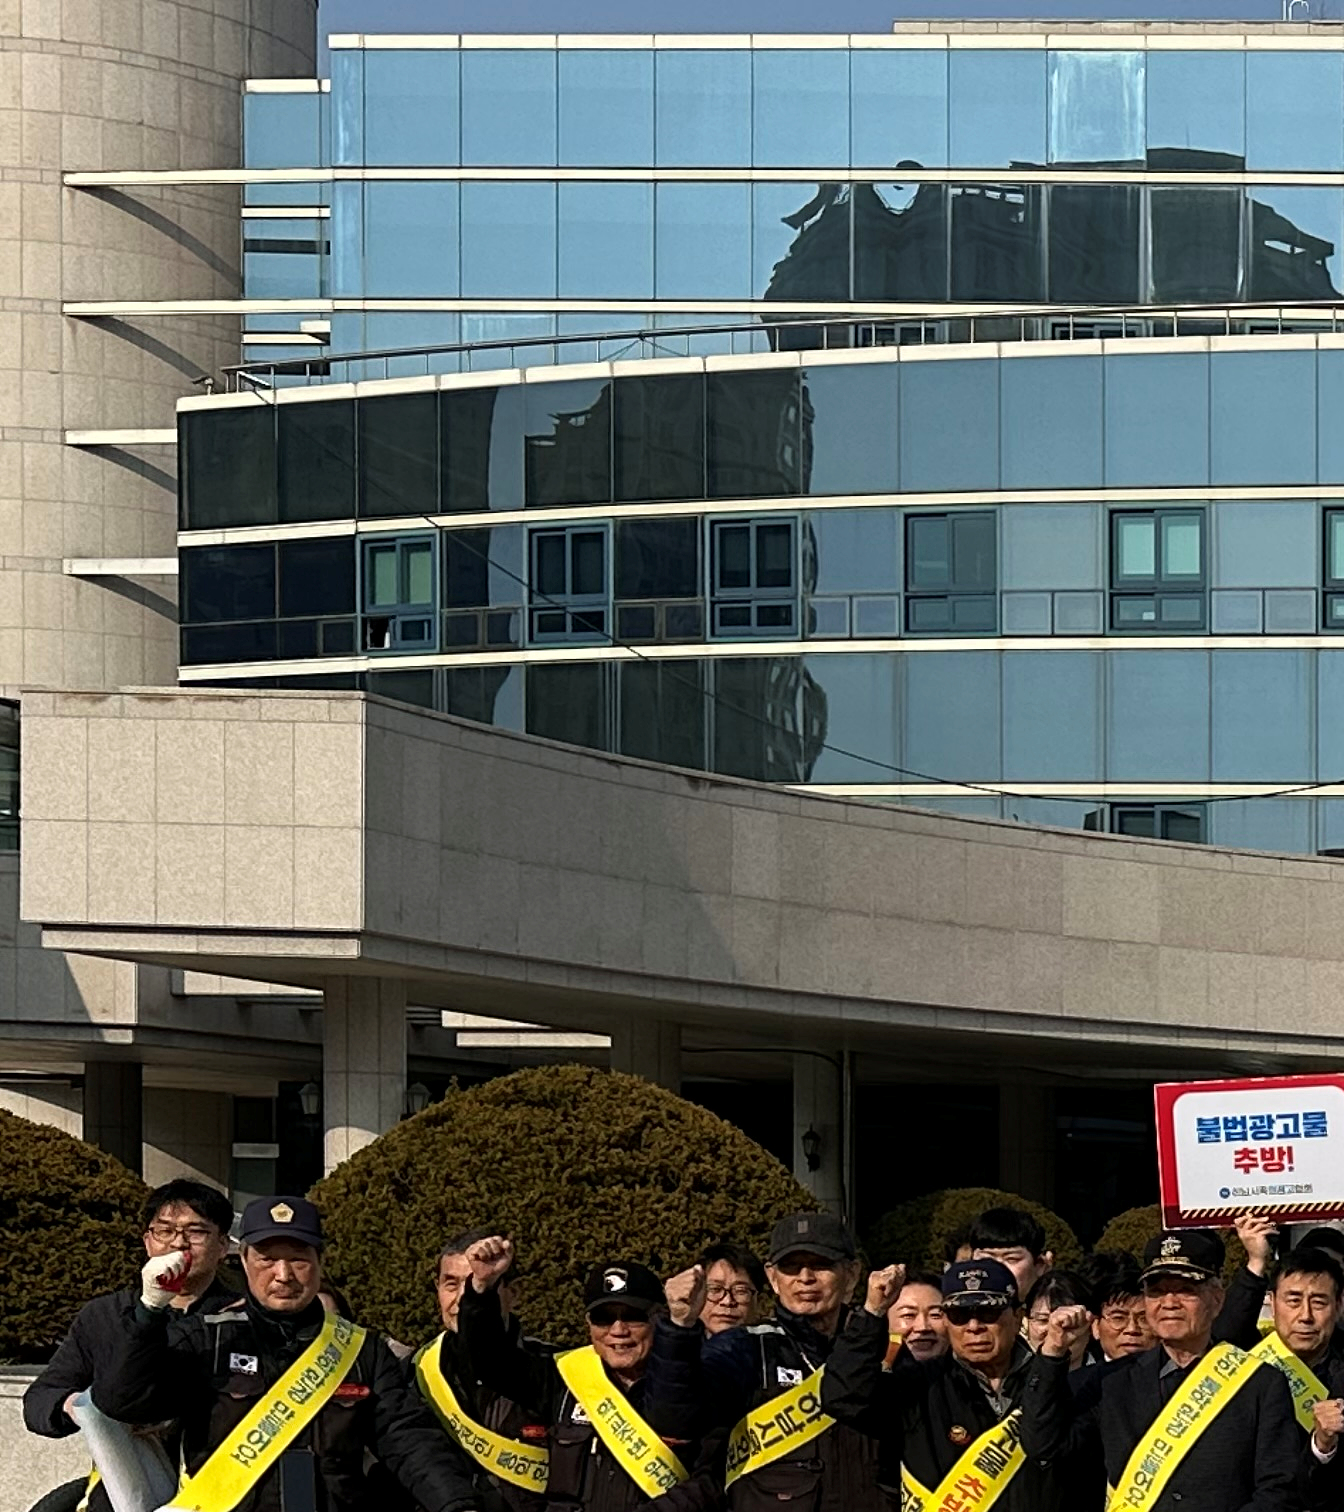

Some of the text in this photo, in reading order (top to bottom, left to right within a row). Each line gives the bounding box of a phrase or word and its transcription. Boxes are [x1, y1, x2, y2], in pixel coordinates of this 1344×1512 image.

[1196, 1111, 1328, 1144] 불법광고물
[1233, 1146, 1295, 1174] 추방!
[593, 1395, 651, 1461] 학교주변
